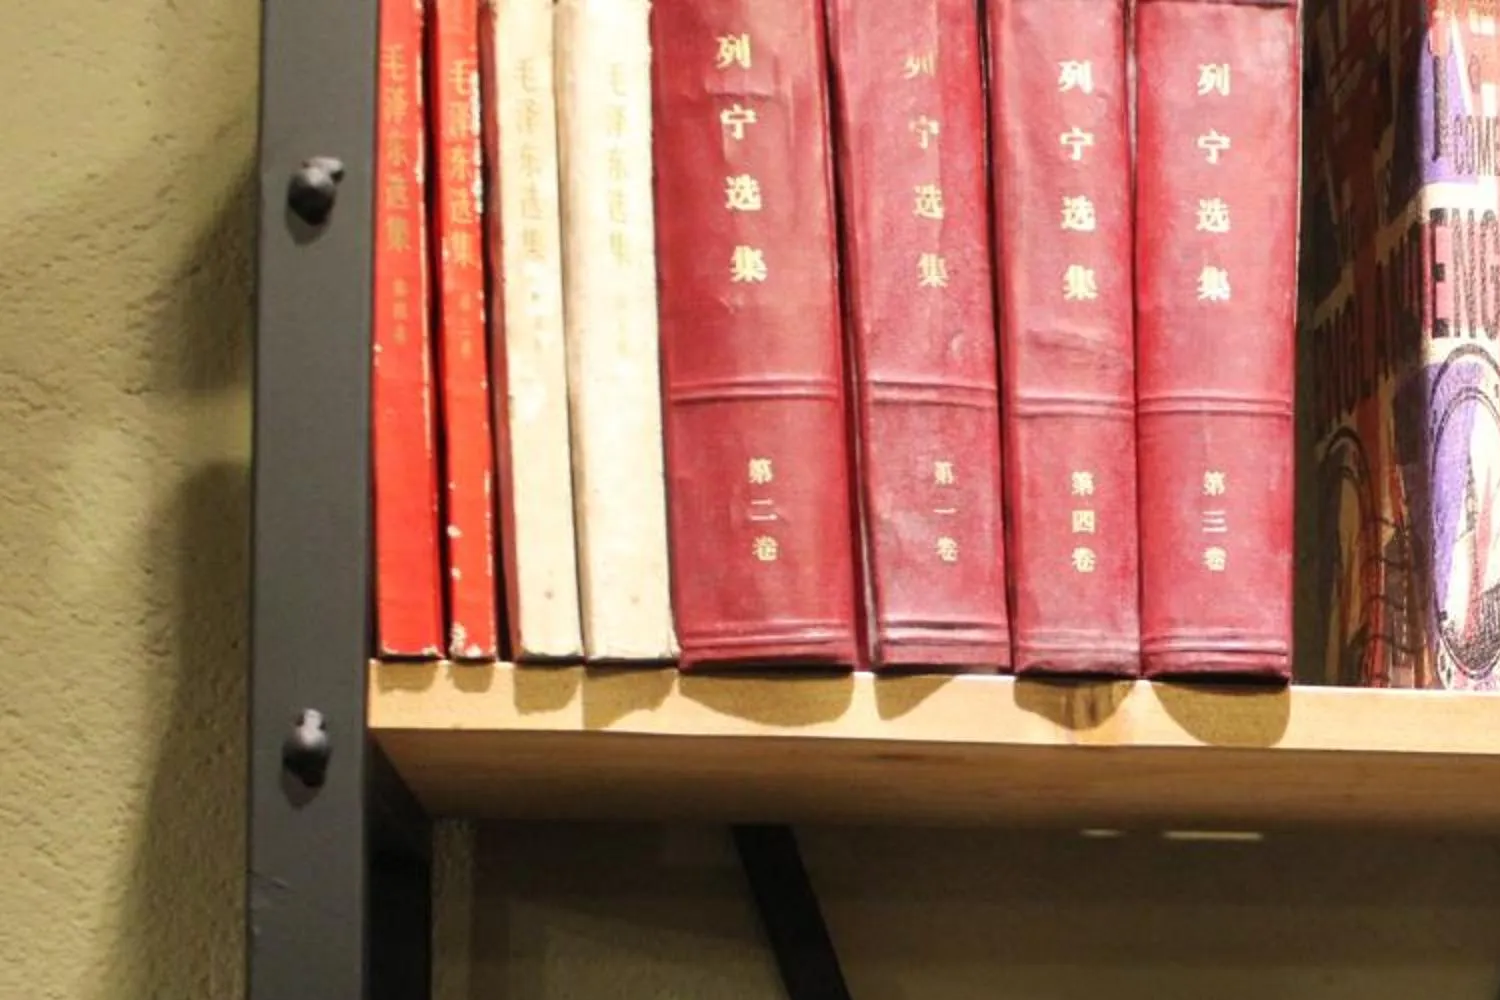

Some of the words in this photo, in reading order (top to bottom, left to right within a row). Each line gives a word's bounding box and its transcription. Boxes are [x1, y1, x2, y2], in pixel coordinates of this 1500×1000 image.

[381, 44, 411, 252] 毛泽东选集
[448, 59, 476, 268] 毛泽东选集
[715, 34, 768, 284] 列宁选集
[904, 51, 948, 288] 列宁选集
[1058, 60, 1099, 302] 列宁选集
[1196, 63, 1232, 302] 列宁选集
[748, 459, 778, 562] 第二卷
[932, 461, 959, 564] 第一卷
[1070, 471, 1097, 573] 第四卷
[1201, 471, 1228, 572] 第三卷
